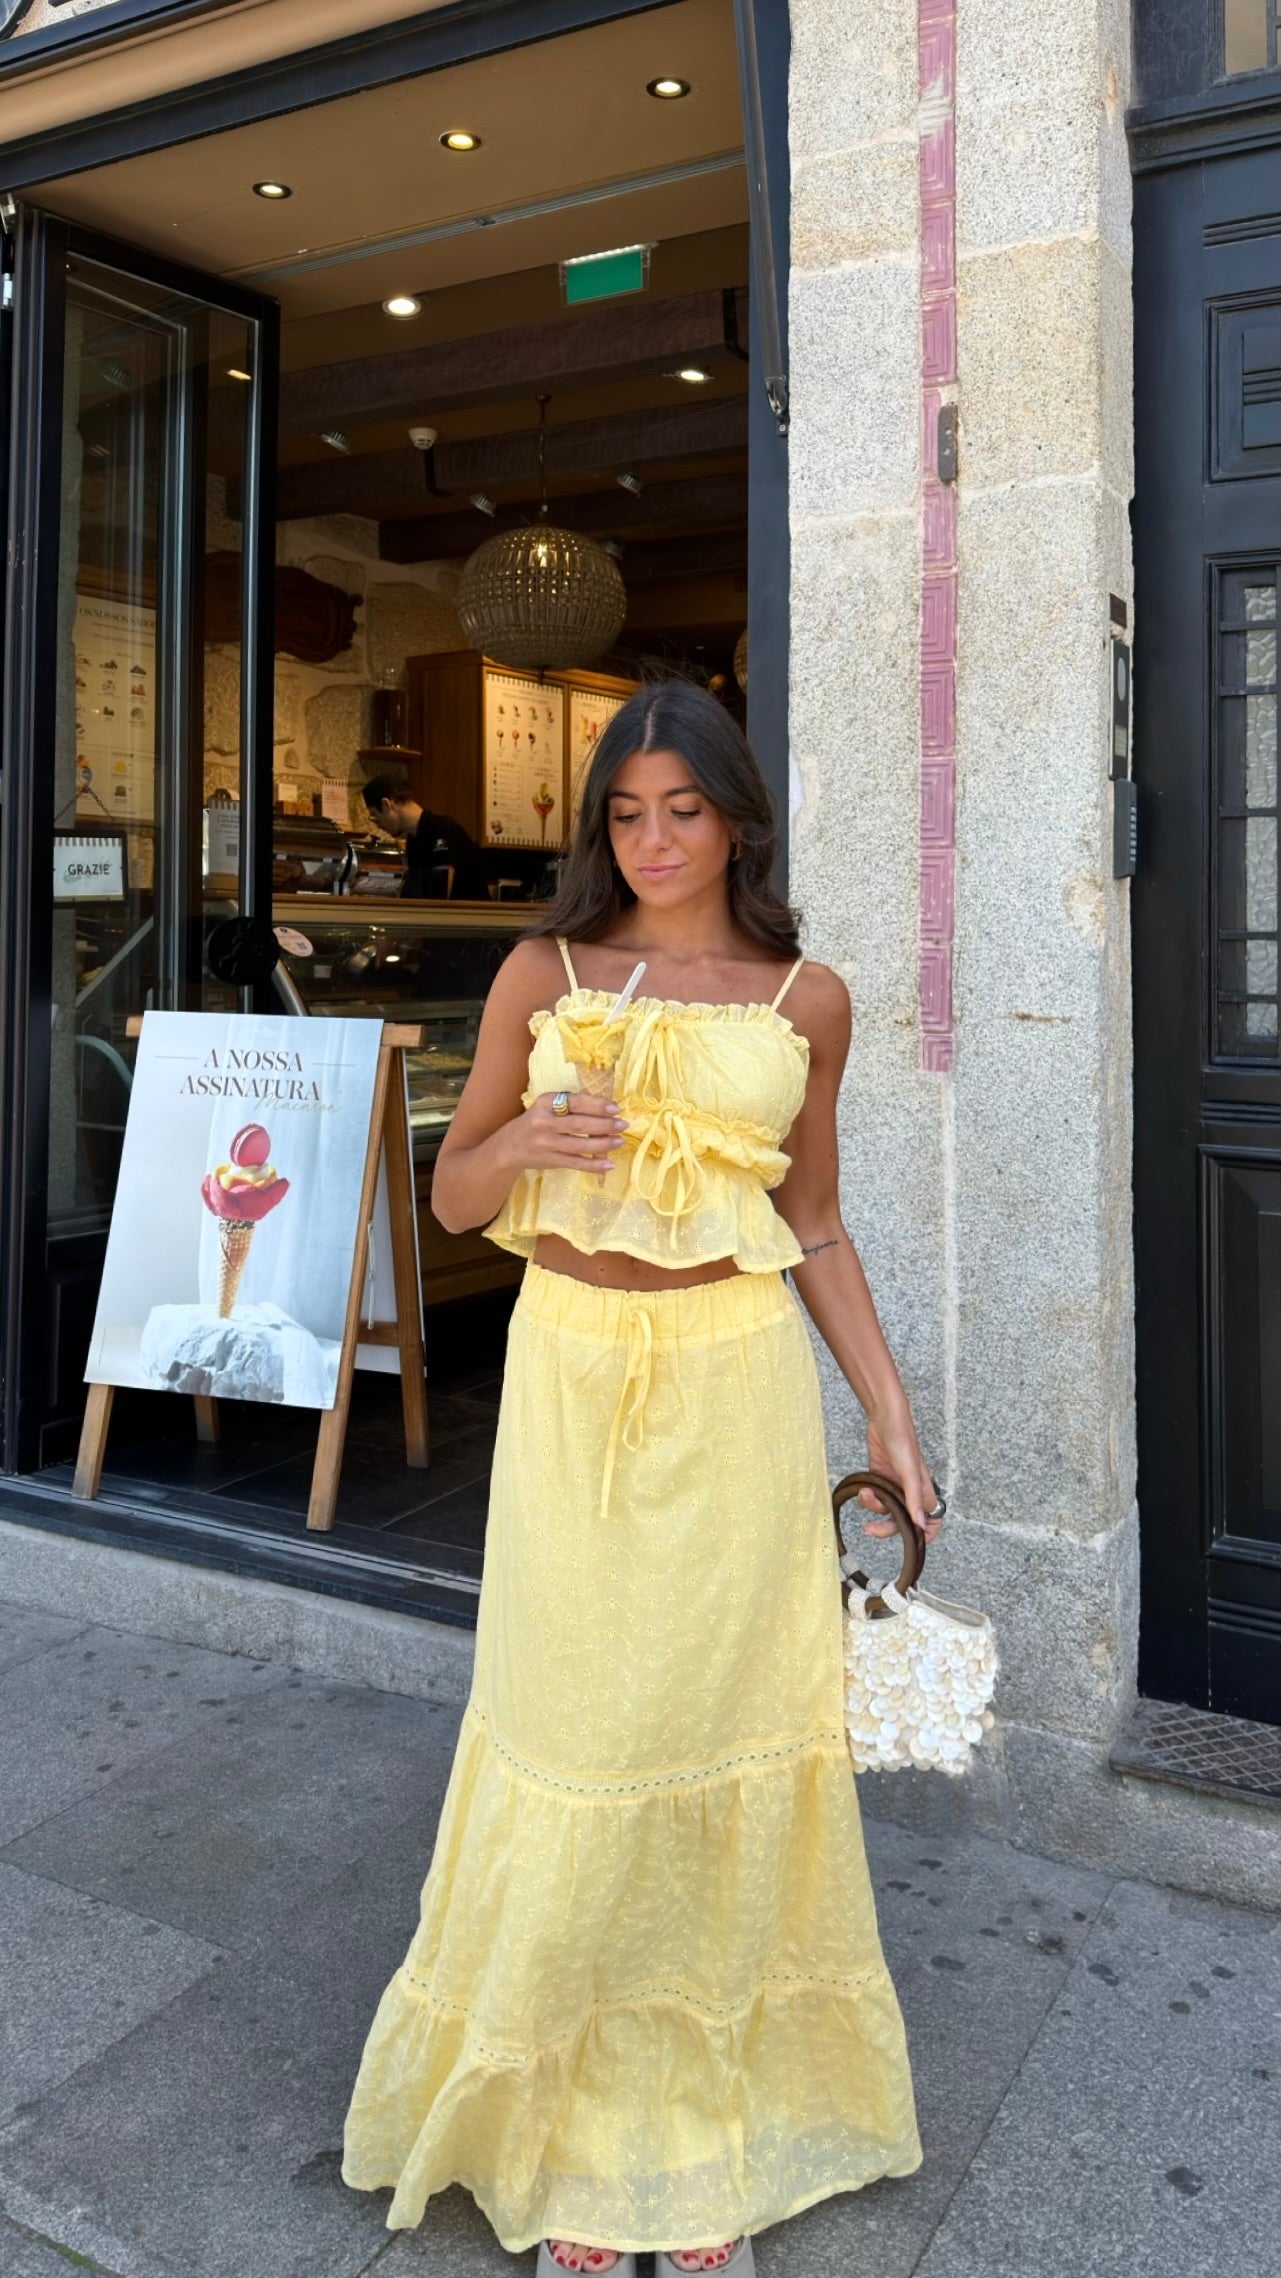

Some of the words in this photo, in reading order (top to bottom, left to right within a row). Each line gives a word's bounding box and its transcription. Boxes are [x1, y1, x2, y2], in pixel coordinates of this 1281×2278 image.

[67, 863, 111, 876] GRAZIE
[203, 1048, 219, 1068] A
[227, 1049, 303, 1072] NOSSA
[180, 1075, 319, 1100] ASSINATURA
